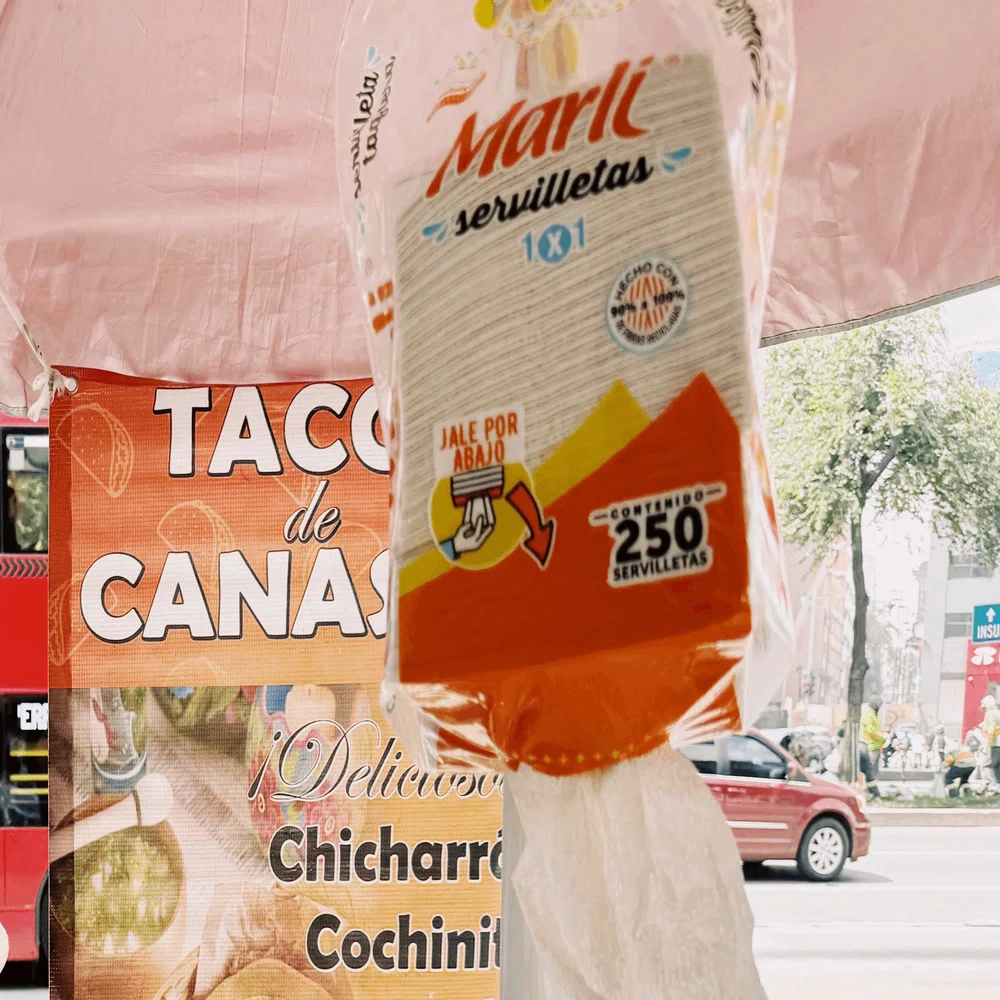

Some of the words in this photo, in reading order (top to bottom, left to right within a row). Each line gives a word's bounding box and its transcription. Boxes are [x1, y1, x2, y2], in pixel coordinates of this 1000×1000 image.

[425, 55, 654, 198] Marli
[454, 153, 653, 236] servilletas
[615, 262, 652, 301] HECHO
[656, 263, 679, 286] CON
[440, 419, 477, 451] JALE
[484, 412, 518, 440] POR
[453, 439, 506, 474] ABAJO
[283, 479, 342, 545] de
[610, 490, 704, 519] CONTENIDO
[614, 506, 703, 564] 250
[613, 552, 708, 582] SERVILLETAS
